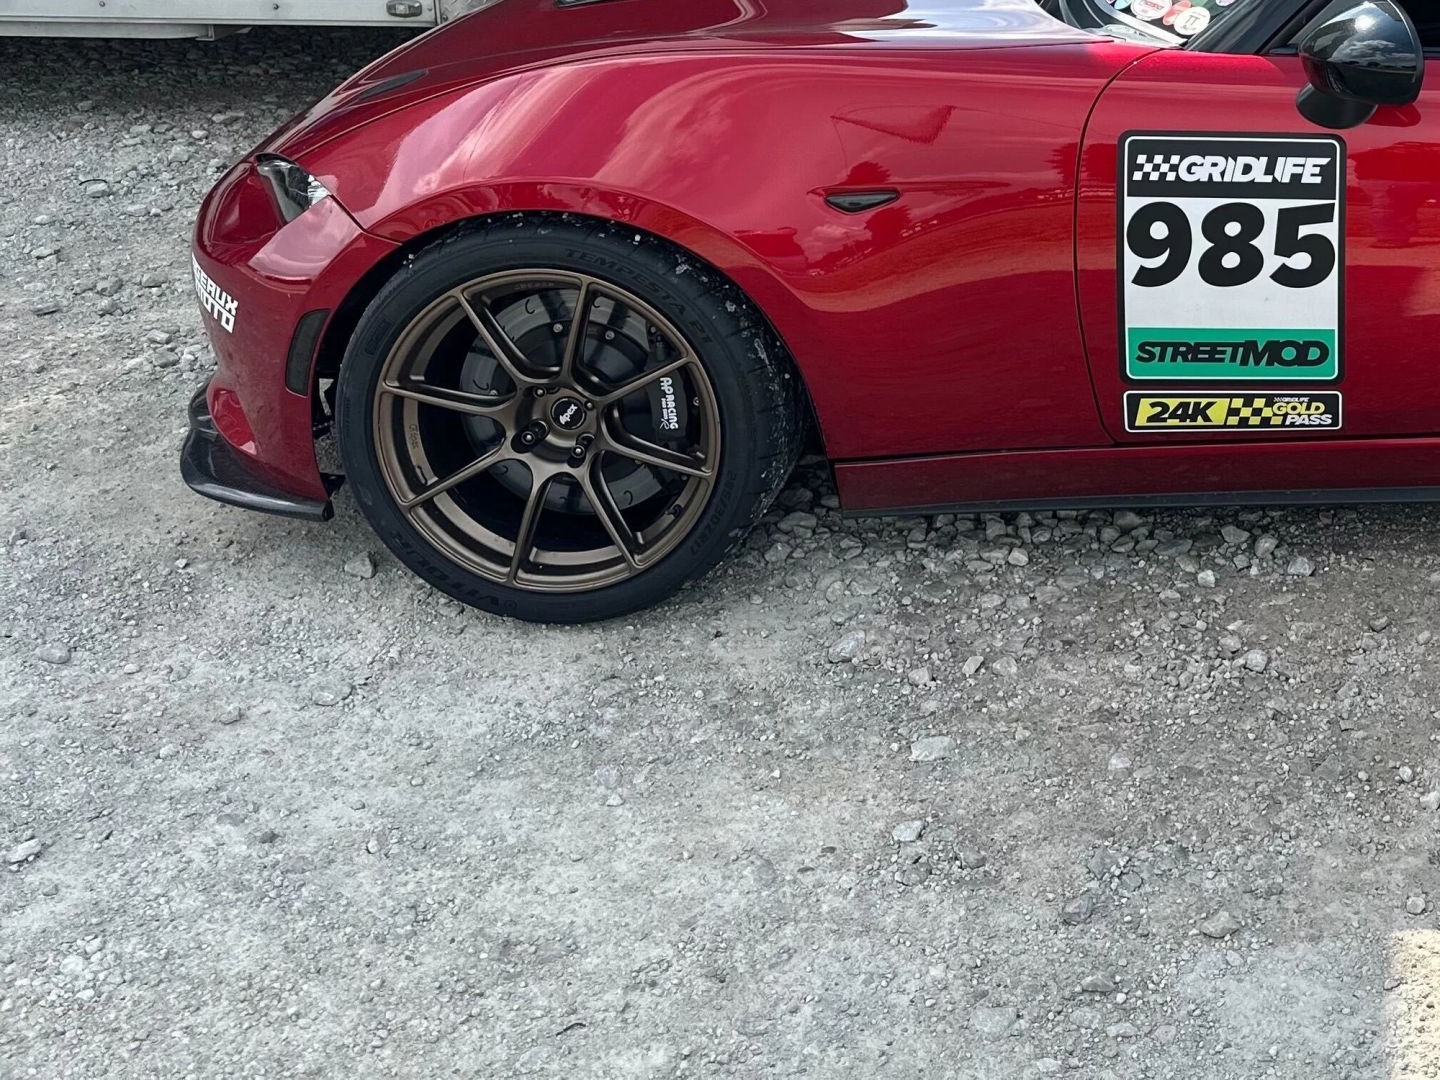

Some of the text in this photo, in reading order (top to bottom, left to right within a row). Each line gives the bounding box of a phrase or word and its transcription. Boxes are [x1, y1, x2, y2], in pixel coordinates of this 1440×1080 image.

[1178, 155, 1332, 184] GRIDLIFE
[1125, 201, 1337, 288] 985
[566, 248, 686, 316] TEMPESTA
[1135, 339, 1330, 368] STREETMOD
[665, 394, 679, 430] RACING
[1144, 400, 1220, 424] 24K
[1272, 402, 1326, 415] GOLD
[1284, 414, 1333, 426] PASS
